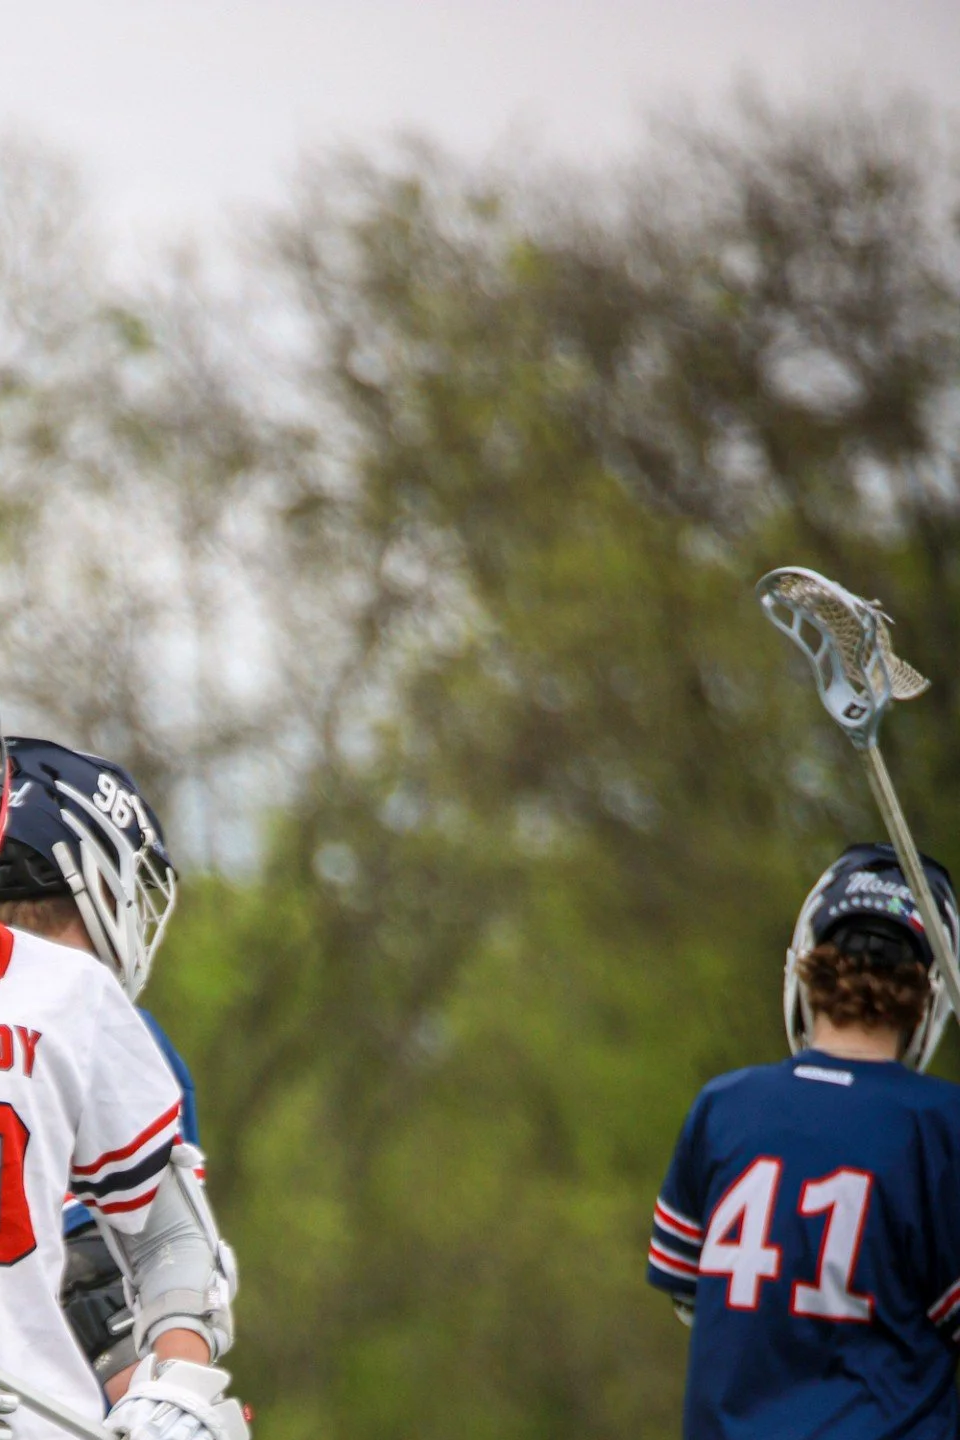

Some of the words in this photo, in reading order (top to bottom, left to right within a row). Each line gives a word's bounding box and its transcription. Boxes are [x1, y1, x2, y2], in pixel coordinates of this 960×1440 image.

[92, 773, 133, 829] 96
[844, 871, 916, 904] Moun
[697, 1155, 874, 1323] 41
